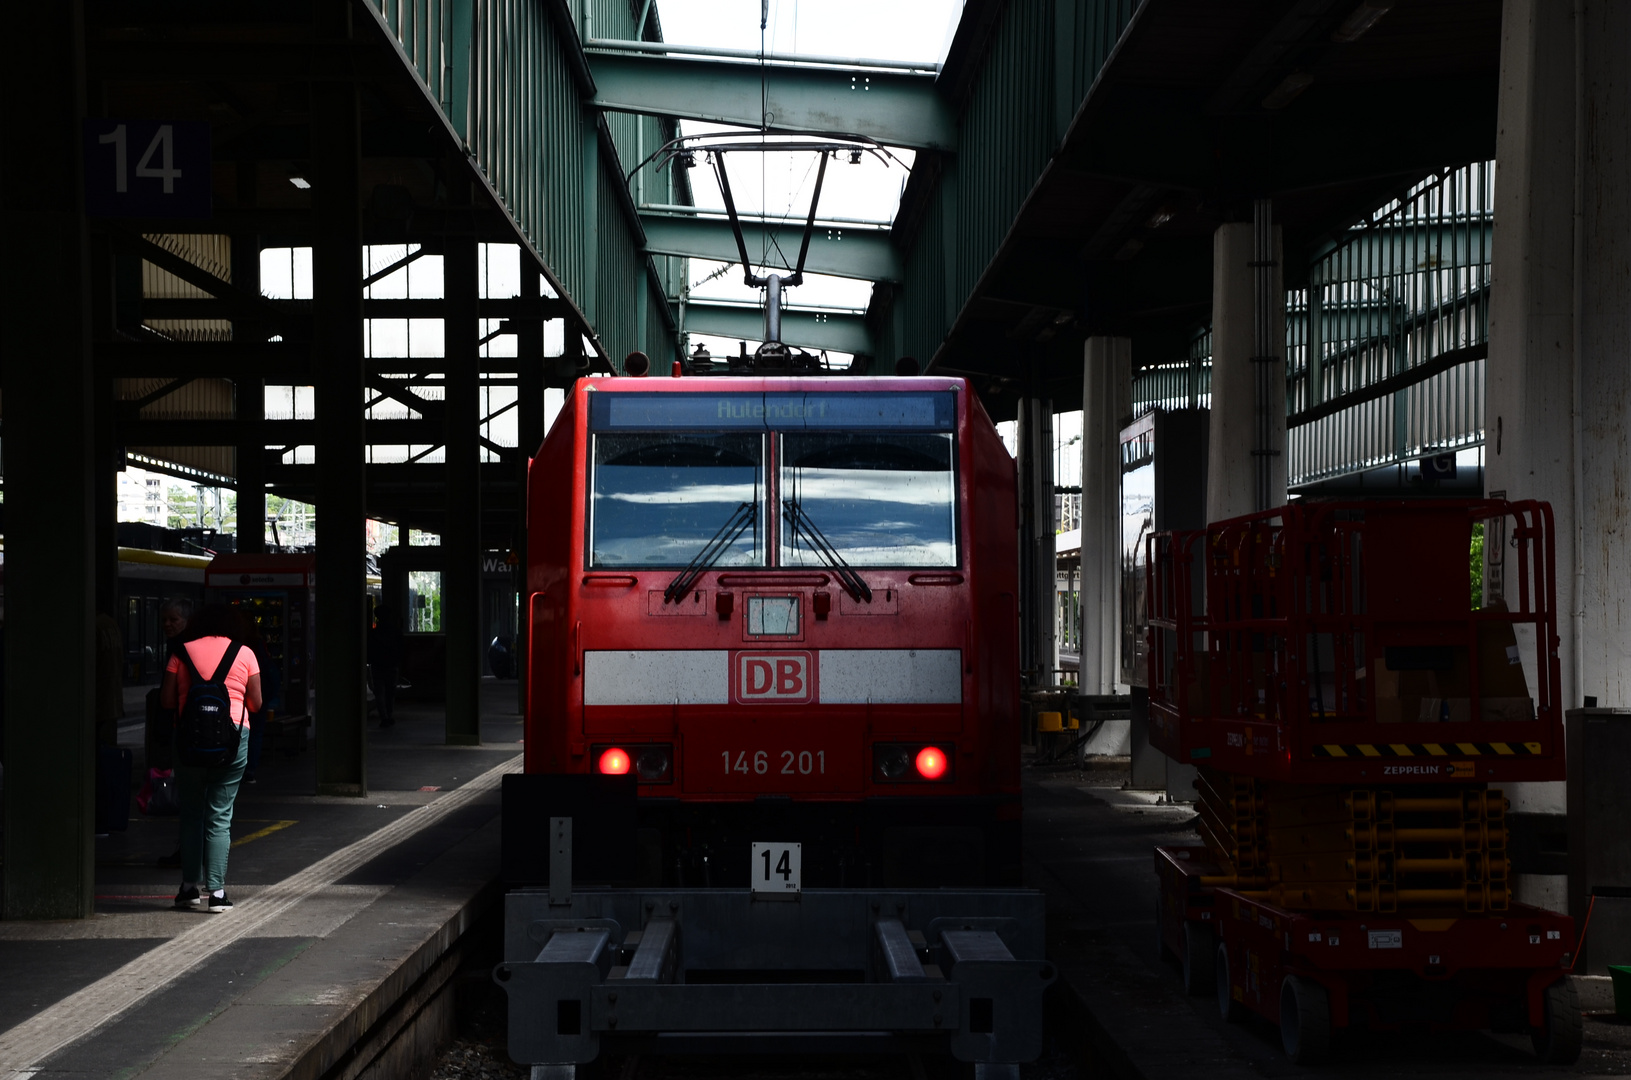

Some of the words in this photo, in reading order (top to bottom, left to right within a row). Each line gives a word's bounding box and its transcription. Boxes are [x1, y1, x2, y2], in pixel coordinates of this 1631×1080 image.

[98, 123, 183, 195] 14
[717, 400, 825, 418] Aulendorf
[1431, 454, 1452, 473] G
[745, 659, 803, 695] DB
[721, 750, 768, 775] 146
[780, 750, 825, 775] 201
[1383, 765, 1440, 775] ZEPPELIN
[761, 849, 792, 881] 14
